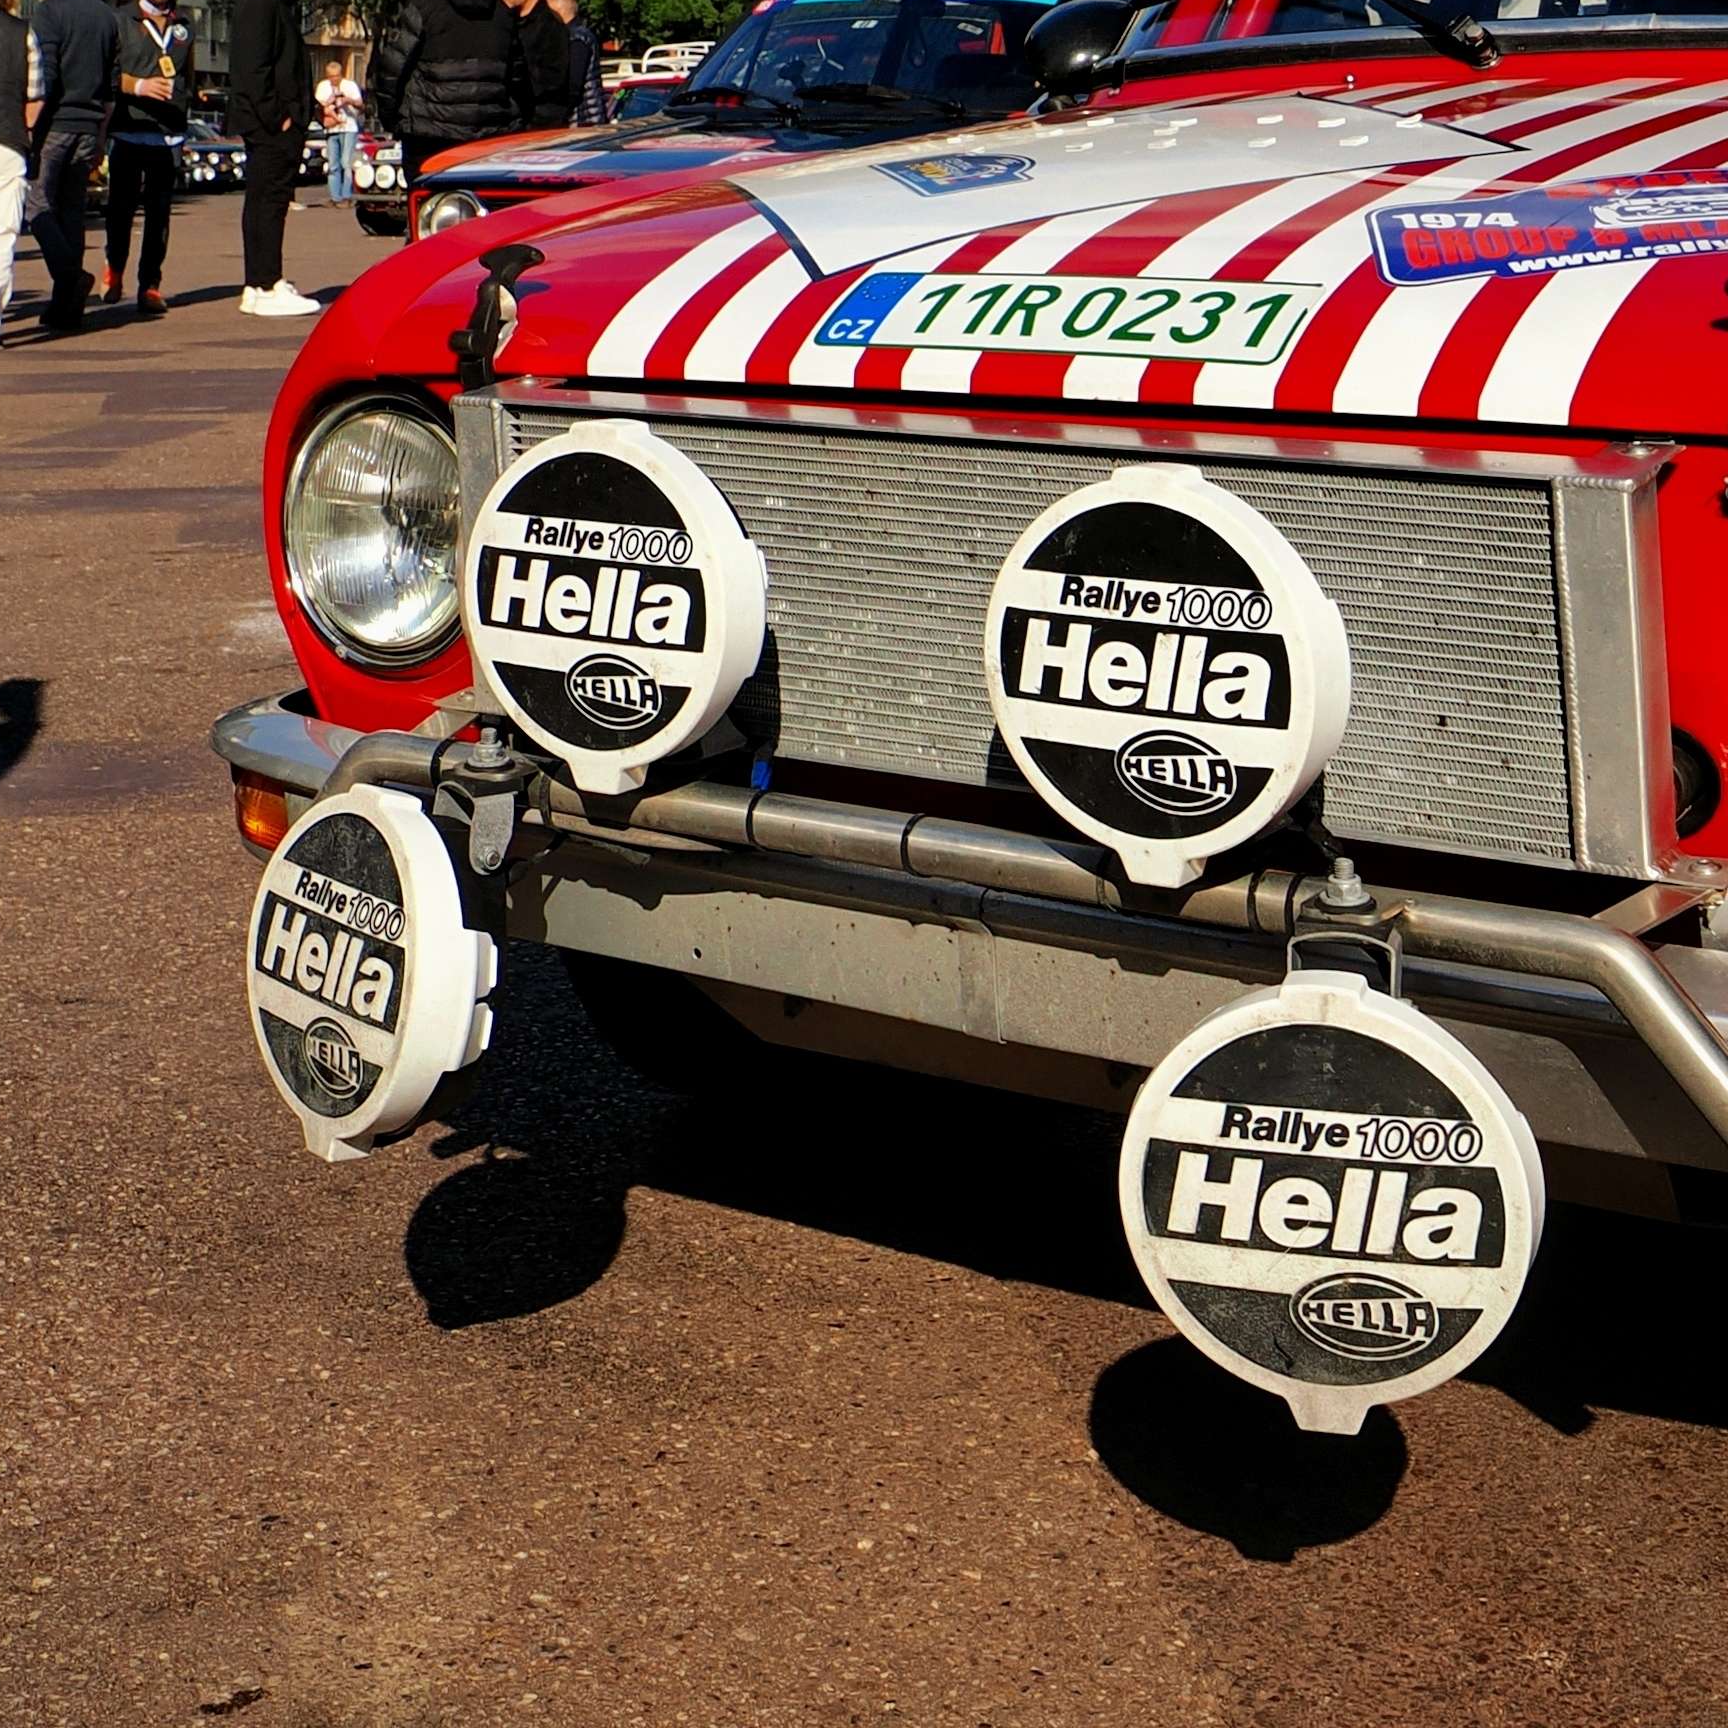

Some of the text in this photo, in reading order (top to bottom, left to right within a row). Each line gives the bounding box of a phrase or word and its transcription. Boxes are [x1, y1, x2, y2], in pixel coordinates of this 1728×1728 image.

[1391, 212, 1519, 230] 1974
[1401, 226, 1577, 270] GROUP
[827, 319, 875, 340] CZ
[913, 283, 1295, 348] 11R 0231
[524, 516, 693, 565] Rallye 1000
[490, 554, 692, 646] Hella
[1059, 574, 1273, 631] Rallye 1000
[572, 676, 659, 712] HELLA
[1018, 617, 1272, 722] Hella
[1123, 757, 1234, 795] HELLA
[294, 869, 406, 941] Rallye 1000
[261, 901, 395, 1023] Hella
[1219, 1104, 1483, 1164] Rallye 1000
[1166, 1150, 1484, 1261] Hella
[1301, 1300, 1436, 1339] HELLA
